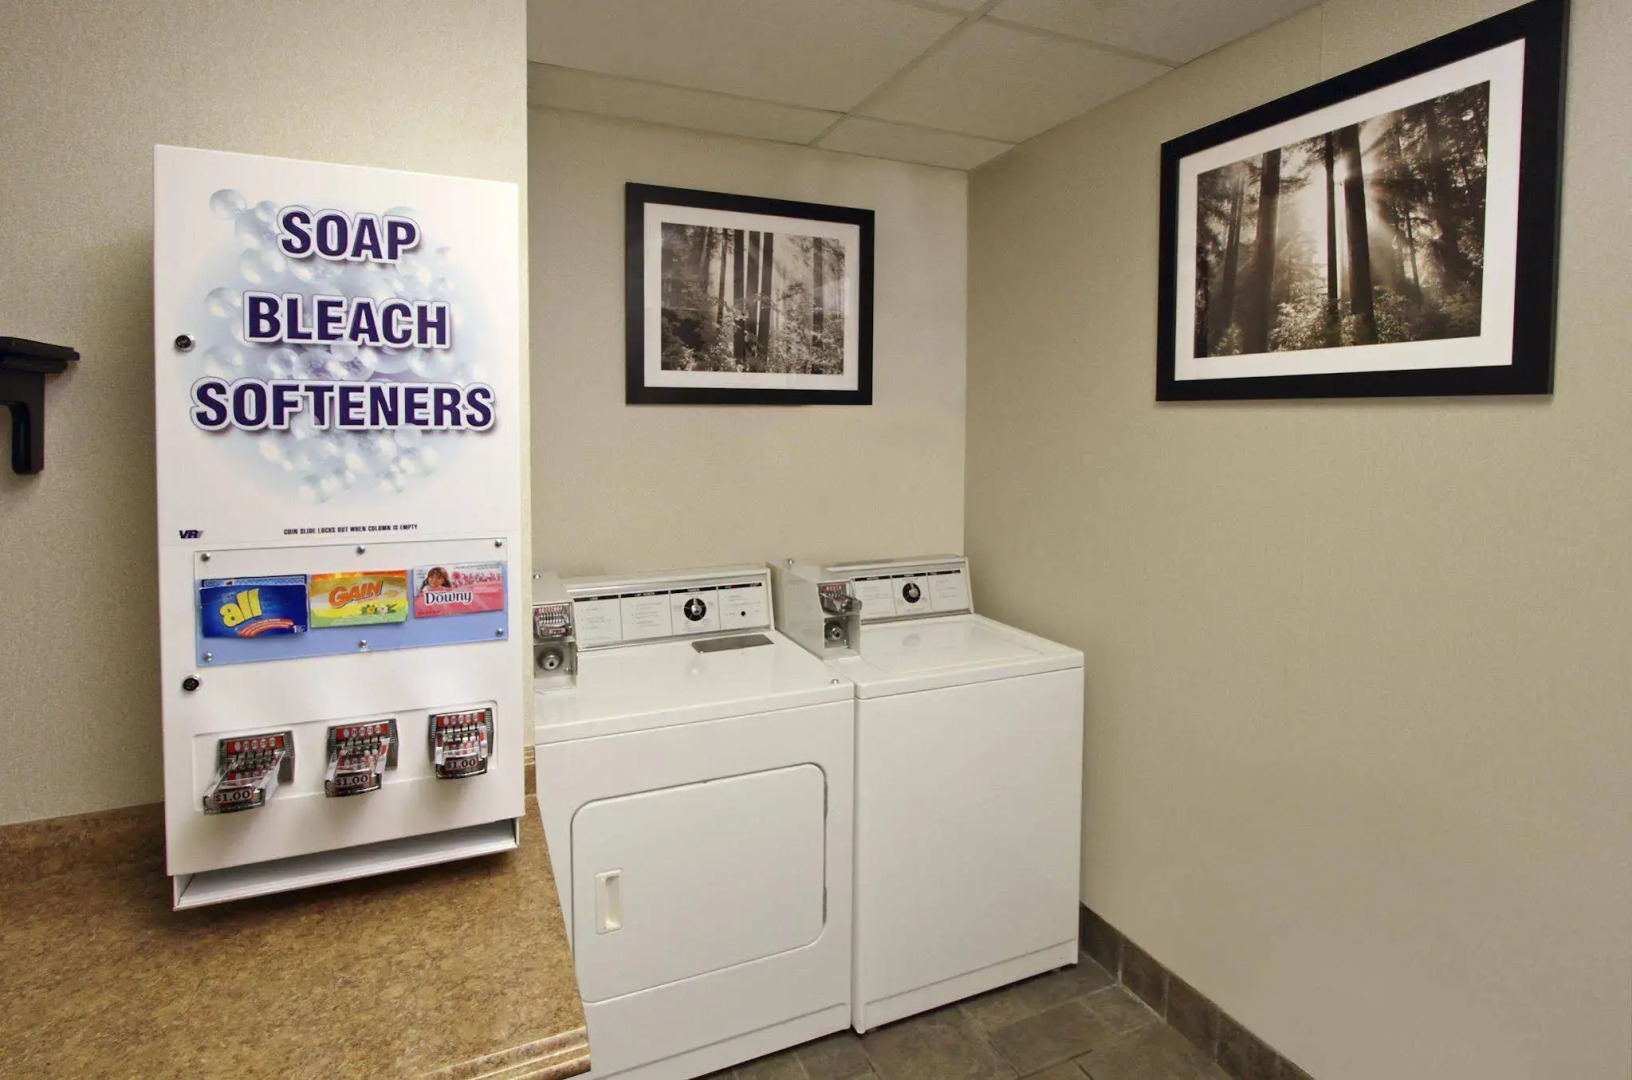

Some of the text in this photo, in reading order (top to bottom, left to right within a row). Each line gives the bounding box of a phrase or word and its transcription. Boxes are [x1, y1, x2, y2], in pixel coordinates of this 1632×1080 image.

[279, 208, 418, 261] SOAP
[246, 294, 450, 347] BLEACH
[193, 379, 494, 429] SOFTENERS
[317, 526, 336, 534] LOCKS
[328, 580, 384, 609] GAIN
[425, 591, 472, 605] Downy
[219, 588, 262, 628] all
[446, 758, 476, 769] $1.00
[336, 775, 369, 786] $1.00
[215, 790, 251, 803] $1.00
